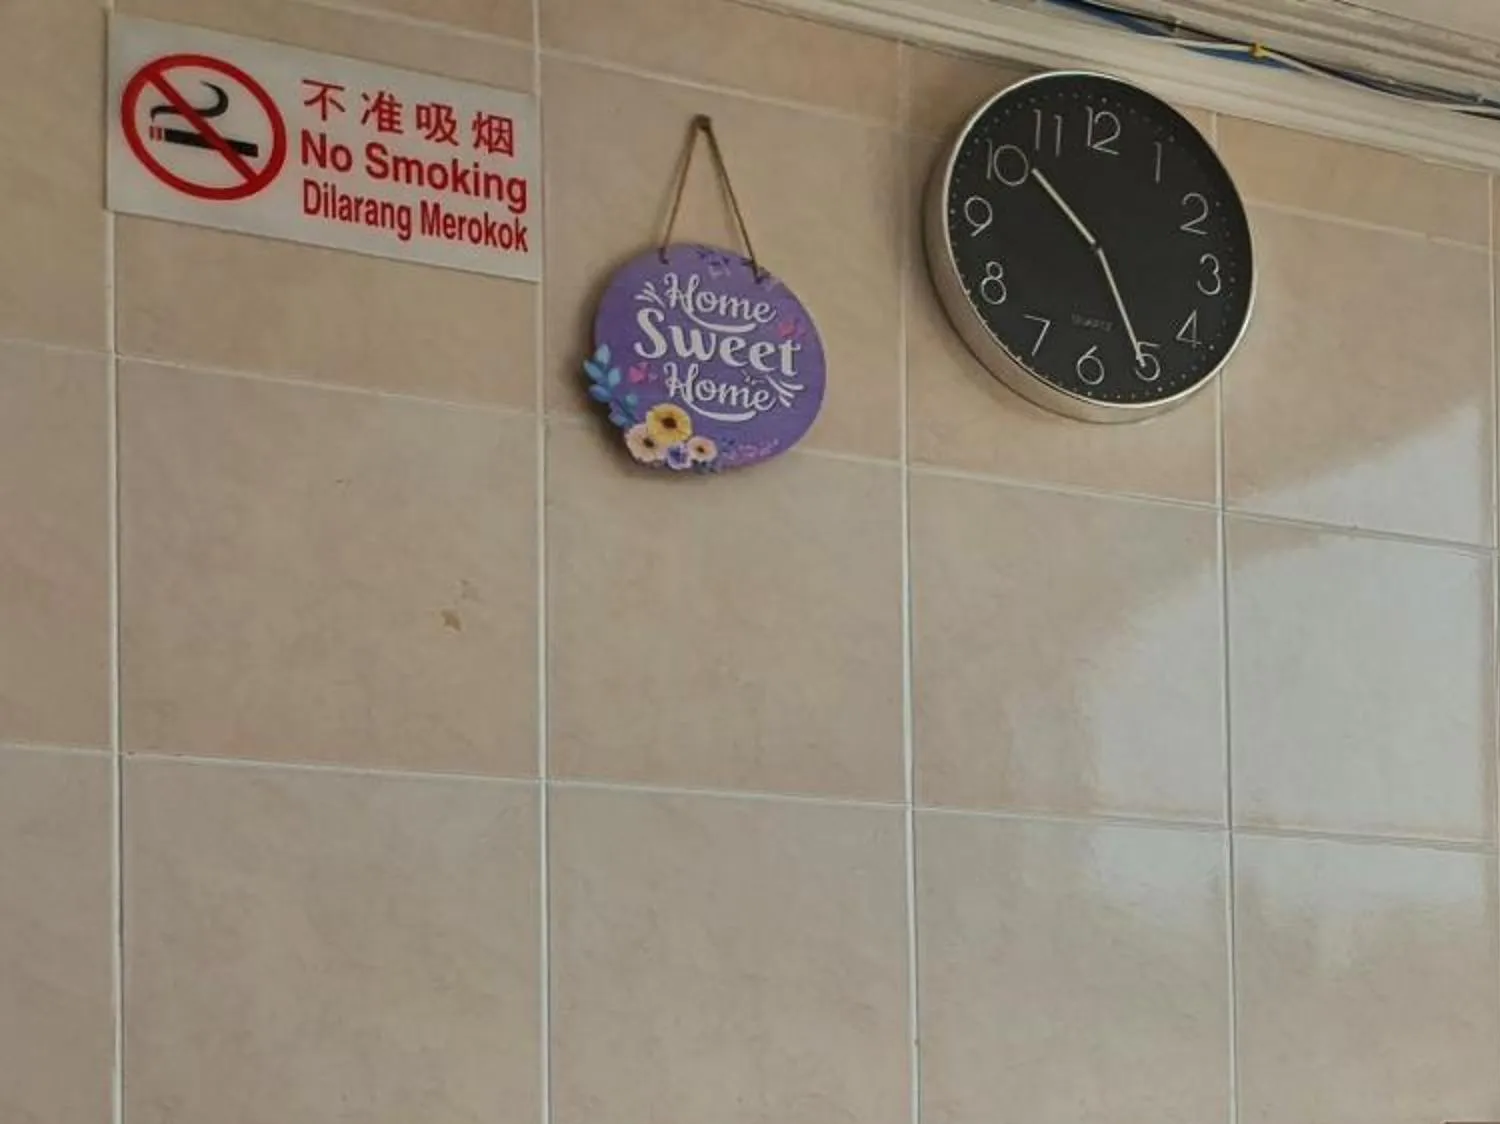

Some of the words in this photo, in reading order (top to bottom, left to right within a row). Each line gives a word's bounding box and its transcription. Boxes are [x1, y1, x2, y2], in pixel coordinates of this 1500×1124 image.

[302, 79, 515, 157] 不准吸烟
[1033, 108, 1064, 157] 11
[1085, 105, 1121, 156] 12
[301, 129, 353, 173] No
[365, 141, 528, 214] Smoking
[986, 138, 1030, 187] 10
[1153, 141, 1163, 184] 1
[303, 178, 412, 240] Dilarang
[420, 205, 529, 253] Merokok
[963, 195, 994, 237] 9
[1179, 192, 1210, 235] 2
[980, 261, 1008, 305] 8
[1197, 253, 1222, 295] 3
[664, 272, 777, 331] Home
[633, 308, 801, 377] Sweet
[1023, 313, 1052, 357] 7
[1175, 309, 1203, 349] 4
[1075, 345, 1106, 386] 6
[1135, 341, 1162, 381] 5
[664, 362, 777, 420] Home
